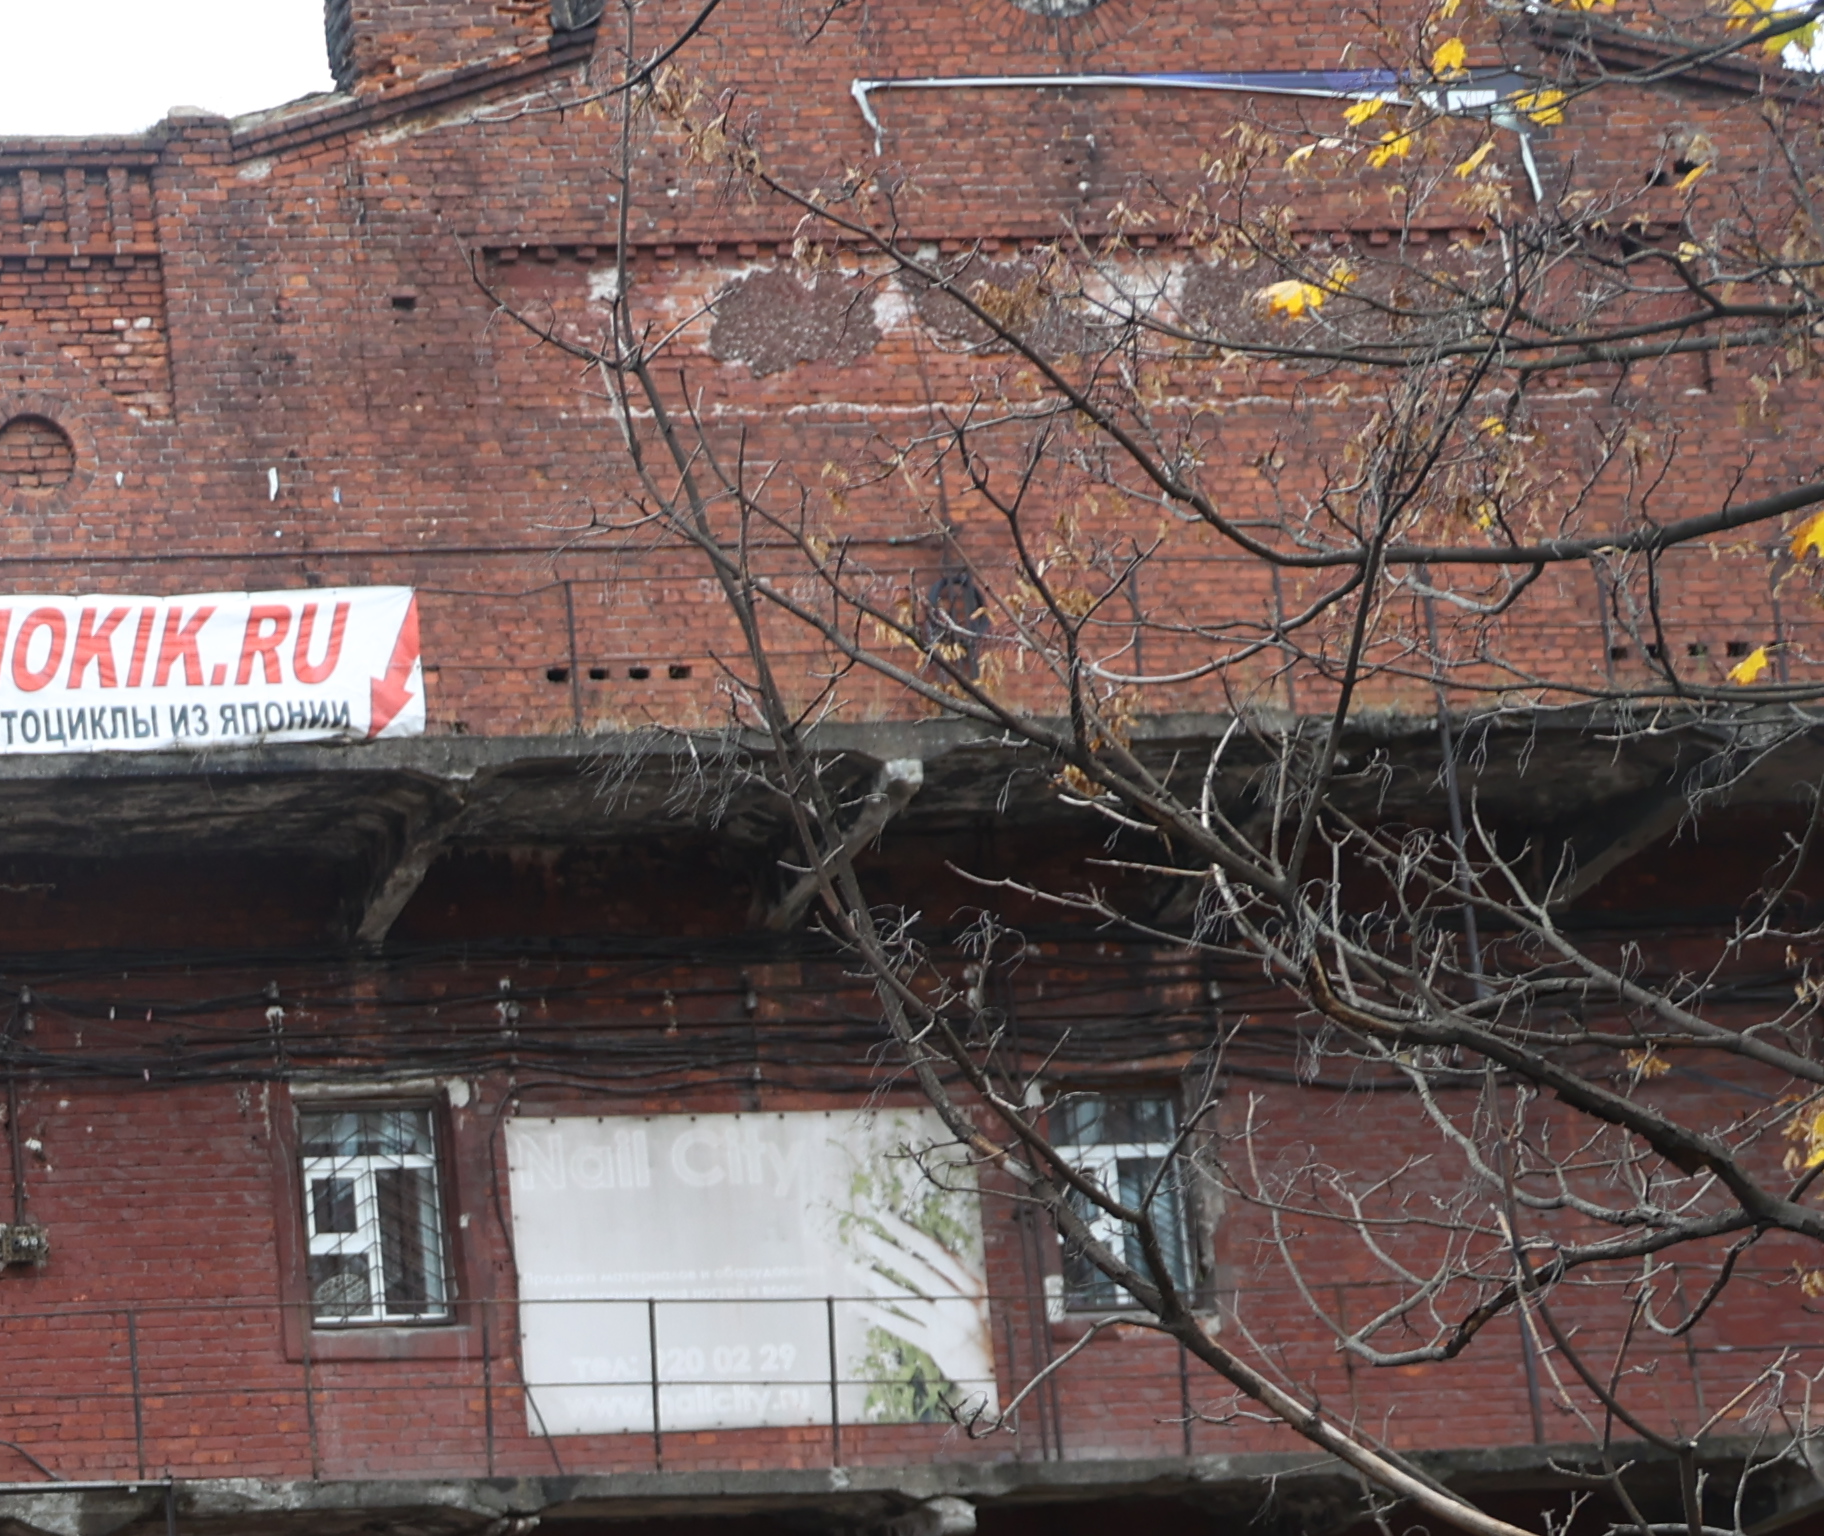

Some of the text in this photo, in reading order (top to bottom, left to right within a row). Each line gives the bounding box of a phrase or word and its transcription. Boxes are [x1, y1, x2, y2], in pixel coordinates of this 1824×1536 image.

[170, 704, 210, 738] ИЗ
[219, 699, 352, 737] ЯПОНИИ
[512, 1126, 805, 1198] Nail City
[713, 1344, 752, 1375] 02
[759, 1342, 797, 1373] 29
